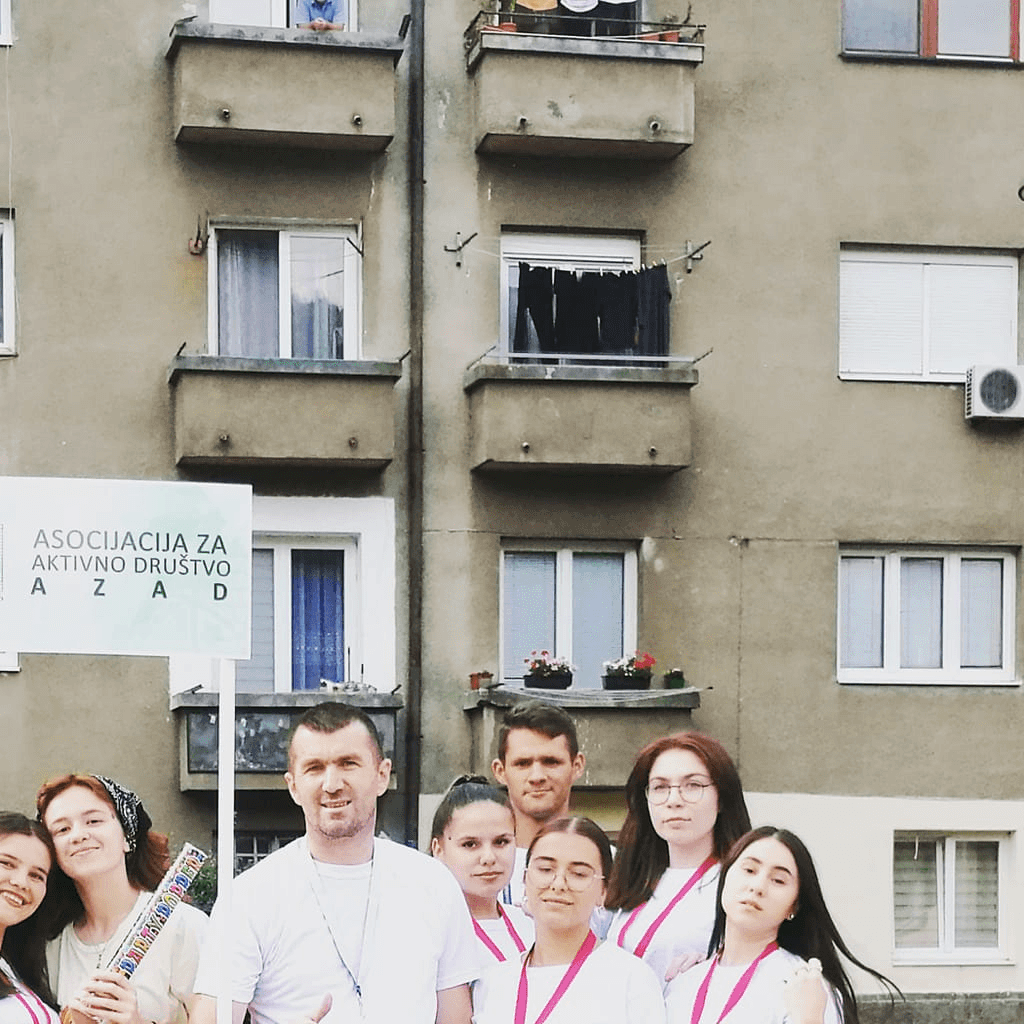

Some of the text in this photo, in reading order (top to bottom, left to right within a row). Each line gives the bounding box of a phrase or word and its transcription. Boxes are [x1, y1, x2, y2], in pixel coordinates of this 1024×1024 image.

[33, 528, 227, 555] ASOCIJACIJA ZA
[31, 552, 231, 578] AKTIVNO DRUŠTVO
